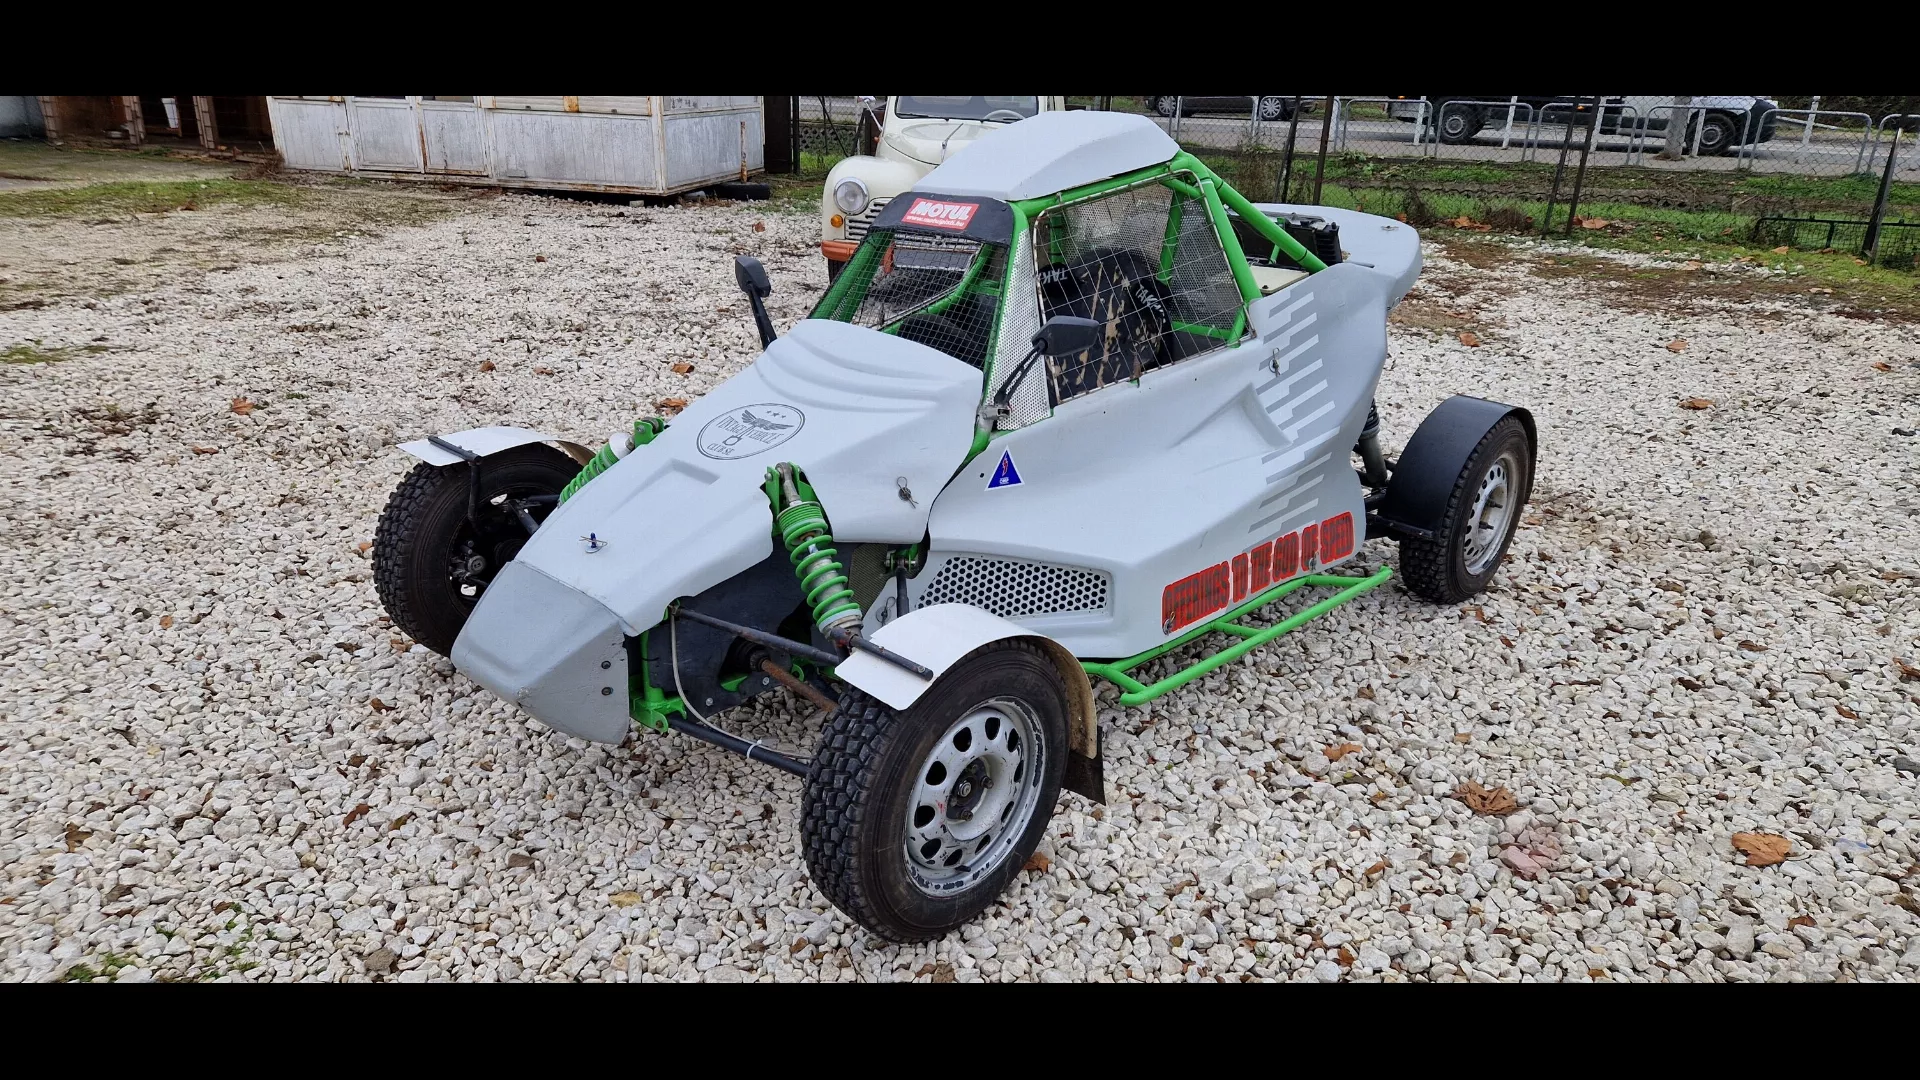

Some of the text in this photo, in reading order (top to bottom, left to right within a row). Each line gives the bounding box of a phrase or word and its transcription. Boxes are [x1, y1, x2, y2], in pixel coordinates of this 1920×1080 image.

[911, 201, 973, 220] MOTUL
[1135, 285, 1167, 324] TAK
[1162, 512, 1354, 632] OFFERINGS TO THE GOD OF SPEED
